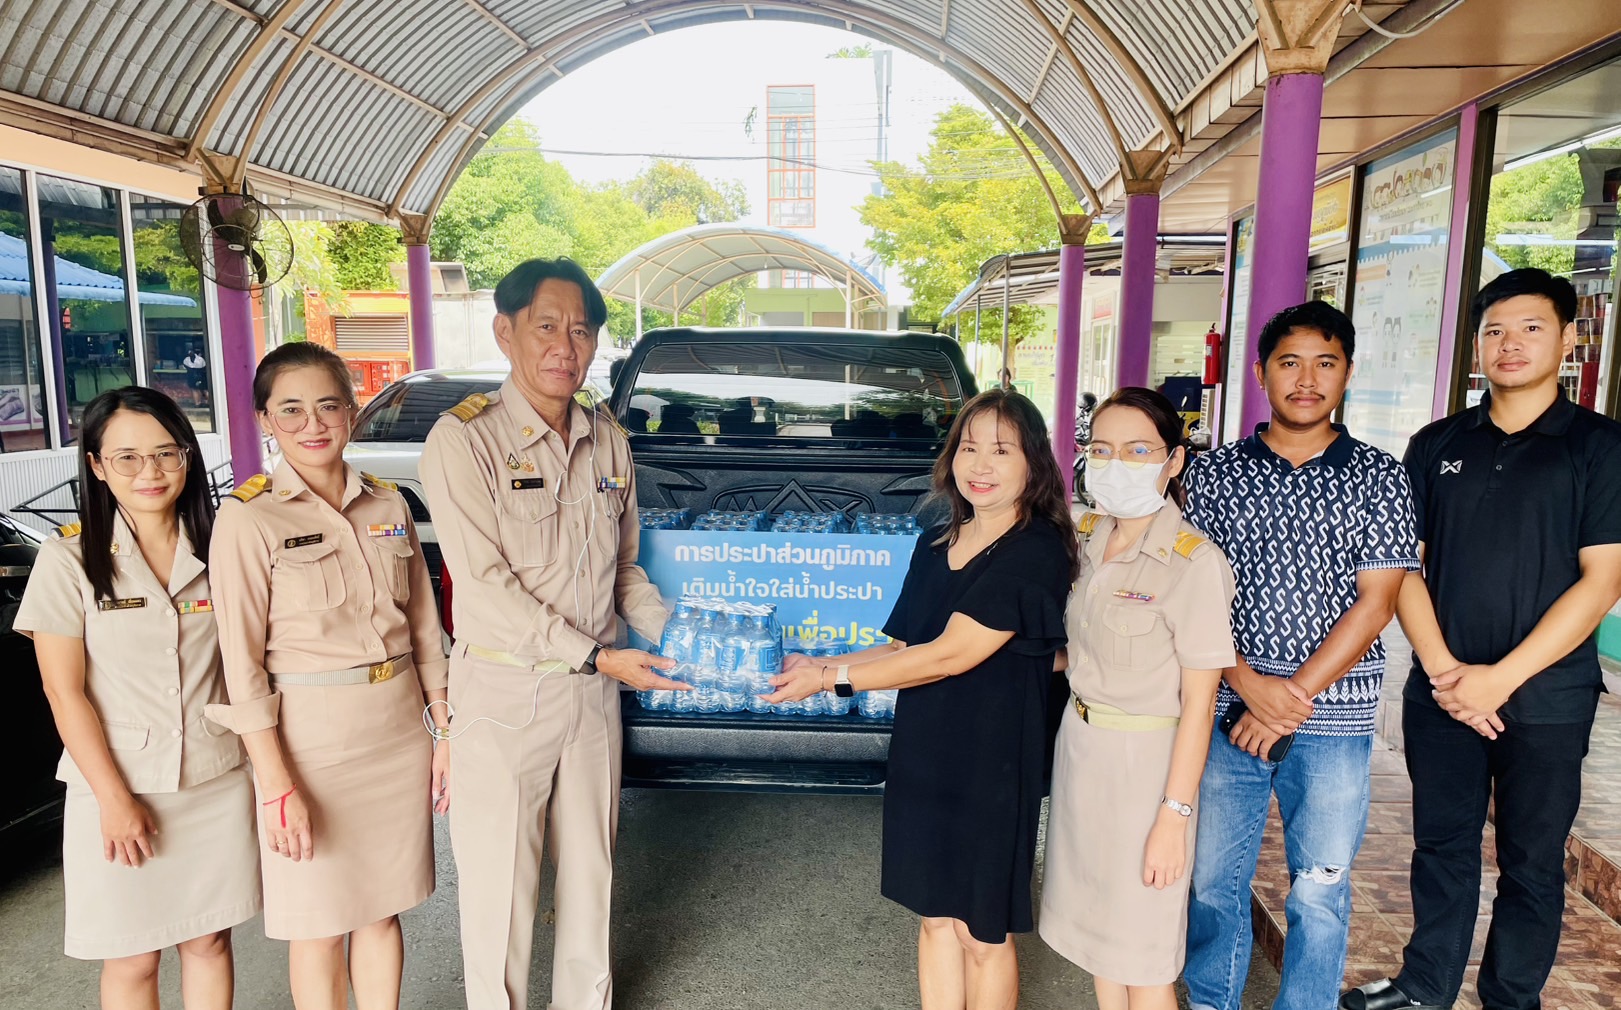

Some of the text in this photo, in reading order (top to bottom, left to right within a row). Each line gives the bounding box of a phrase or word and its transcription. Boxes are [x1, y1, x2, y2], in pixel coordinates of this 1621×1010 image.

[675, 543, 891, 570] การประปาส่วนภูมิภาค
